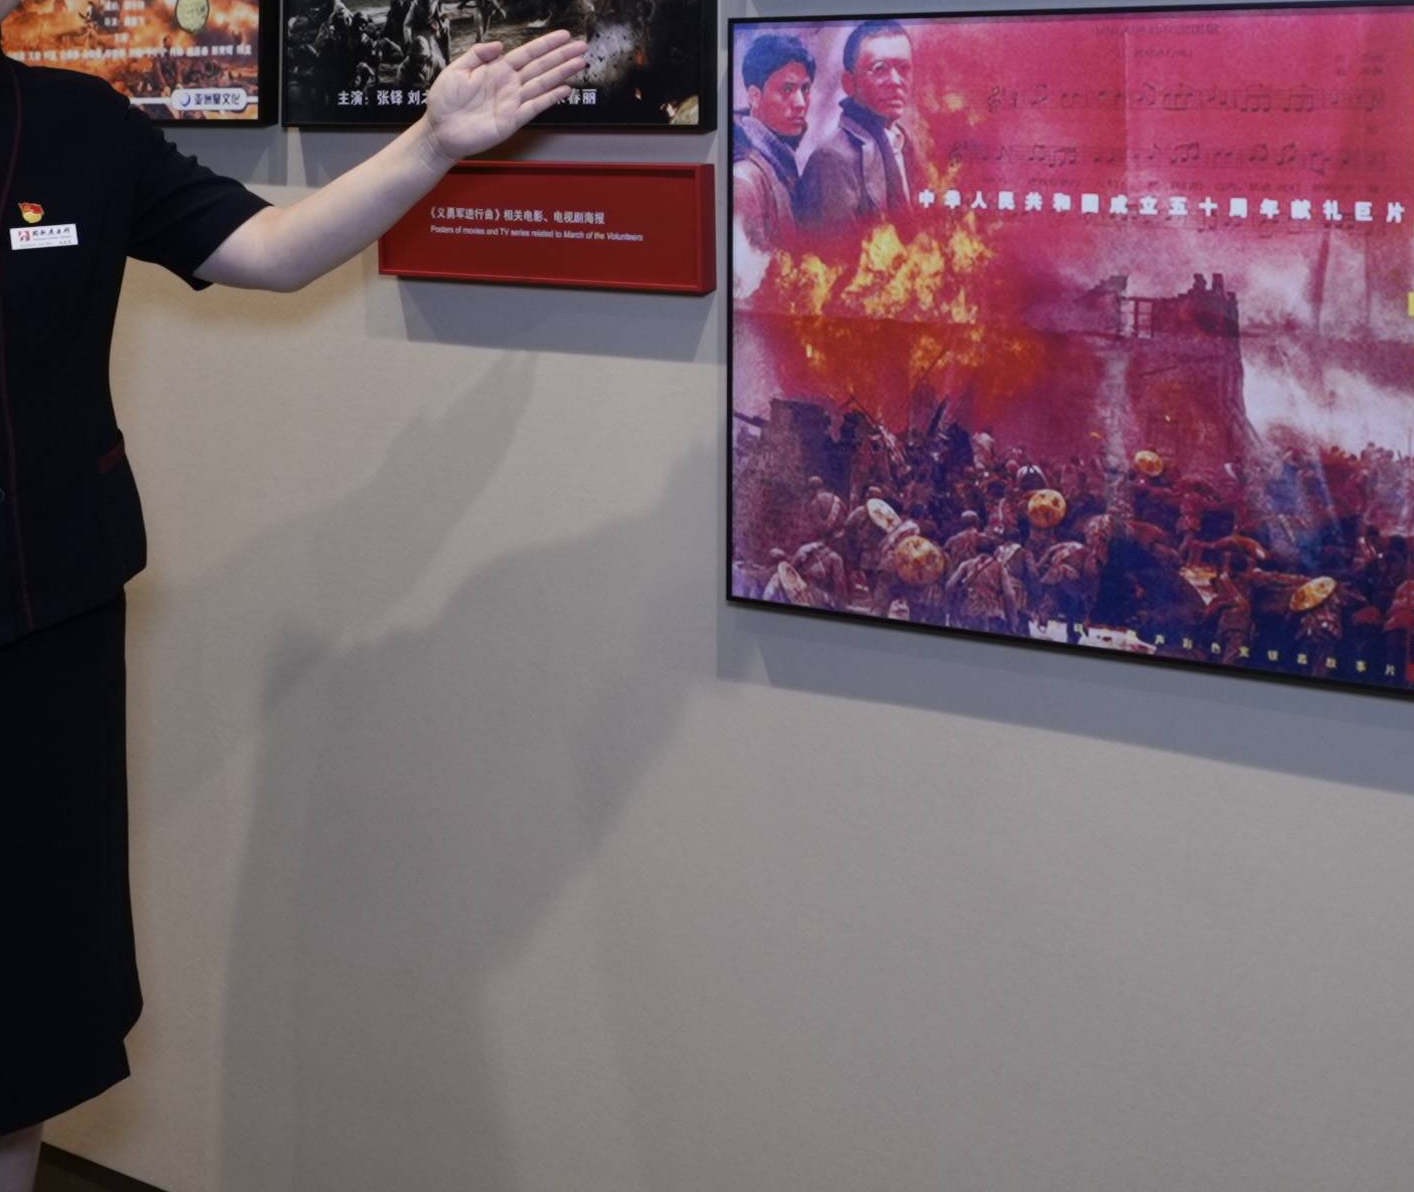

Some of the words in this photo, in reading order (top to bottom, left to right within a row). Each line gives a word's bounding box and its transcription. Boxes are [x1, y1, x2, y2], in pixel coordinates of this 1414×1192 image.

[917, 189, 1407, 225] 中华人民共和国成立五十周年献礼巨片
[455, 226, 462, 234] of
[486, 227, 499, 236] and
[500, 228, 509, 236] TV
[555, 230, 562, 238] to
[563, 230, 585, 239] March
[586, 231, 593, 239] of
[593, 231, 605, 240] the
